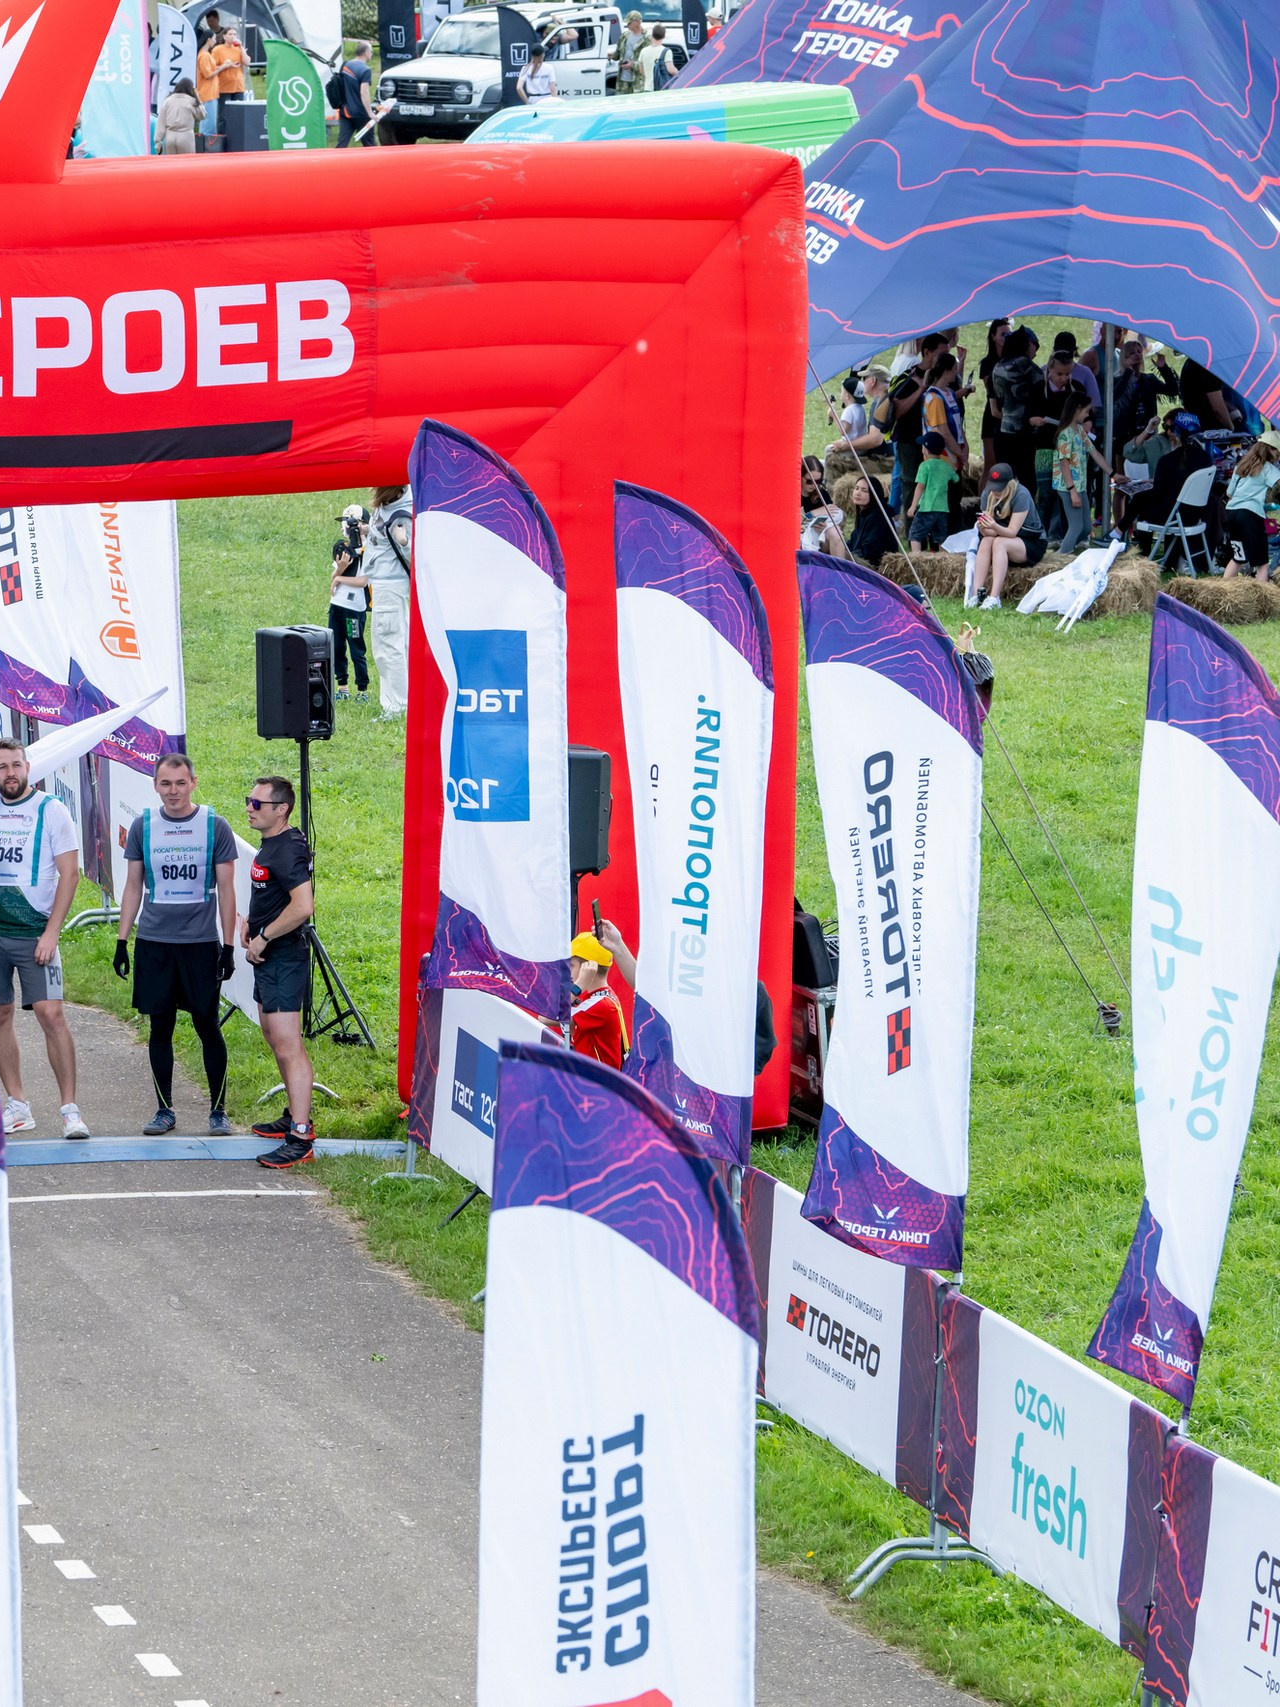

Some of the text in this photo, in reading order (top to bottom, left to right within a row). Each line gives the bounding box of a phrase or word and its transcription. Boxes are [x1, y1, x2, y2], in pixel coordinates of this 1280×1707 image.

[820, 0, 913, 38] ГОНКА
[169, 24, 185, 97] TAN
[792, 31, 900, 69] ГЕРОЕВ
[804, 181, 865, 226] ГОНКА
[804, 225, 840, 264] ОЕВ
[161, 863, 198, 881] 6040
[792, 1259, 883, 1323] ШИНЫ ДЛЯ ЛЕГКОВЫХ АВТОМОБИЛЕЙ
[808, 1304, 881, 1378] TORERO
[806, 1350, 856, 1392] УПРАВЛЯЙ ЭНЕРГИЕЙ
[1014, 1378, 1065, 1441] OZON
[1011, 1431, 1087, 1561] fresh
